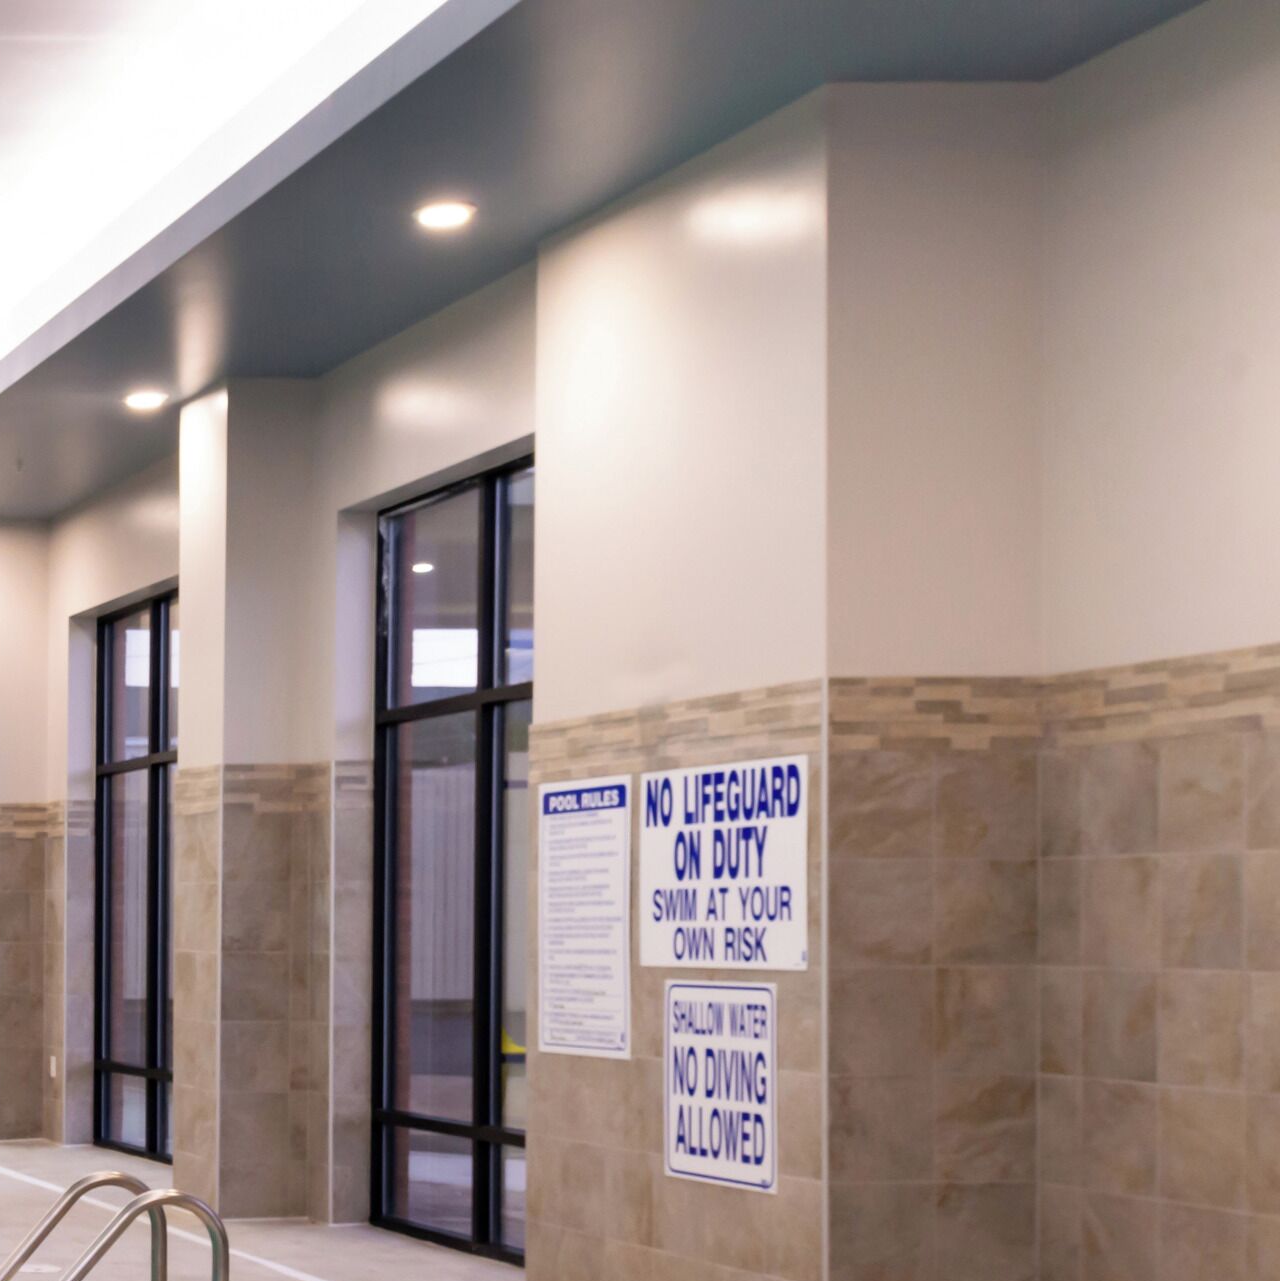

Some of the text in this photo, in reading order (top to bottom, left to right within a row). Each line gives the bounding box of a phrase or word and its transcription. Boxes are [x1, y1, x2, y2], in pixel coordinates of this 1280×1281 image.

[549, 789, 619, 812] POOL RULES
[646, 764, 800, 828] NO LIFEGUARD
[674, 826, 767, 881] ON DUTY
[653, 885, 792, 922] SWIM AT YOUR
[673, 926, 767, 962] OWN RISK
[673, 1000, 767, 1039] SHALLOW WATER
[673, 1045, 766, 1104] NO DIVING
[675, 1104, 766, 1165] ALLOWED
